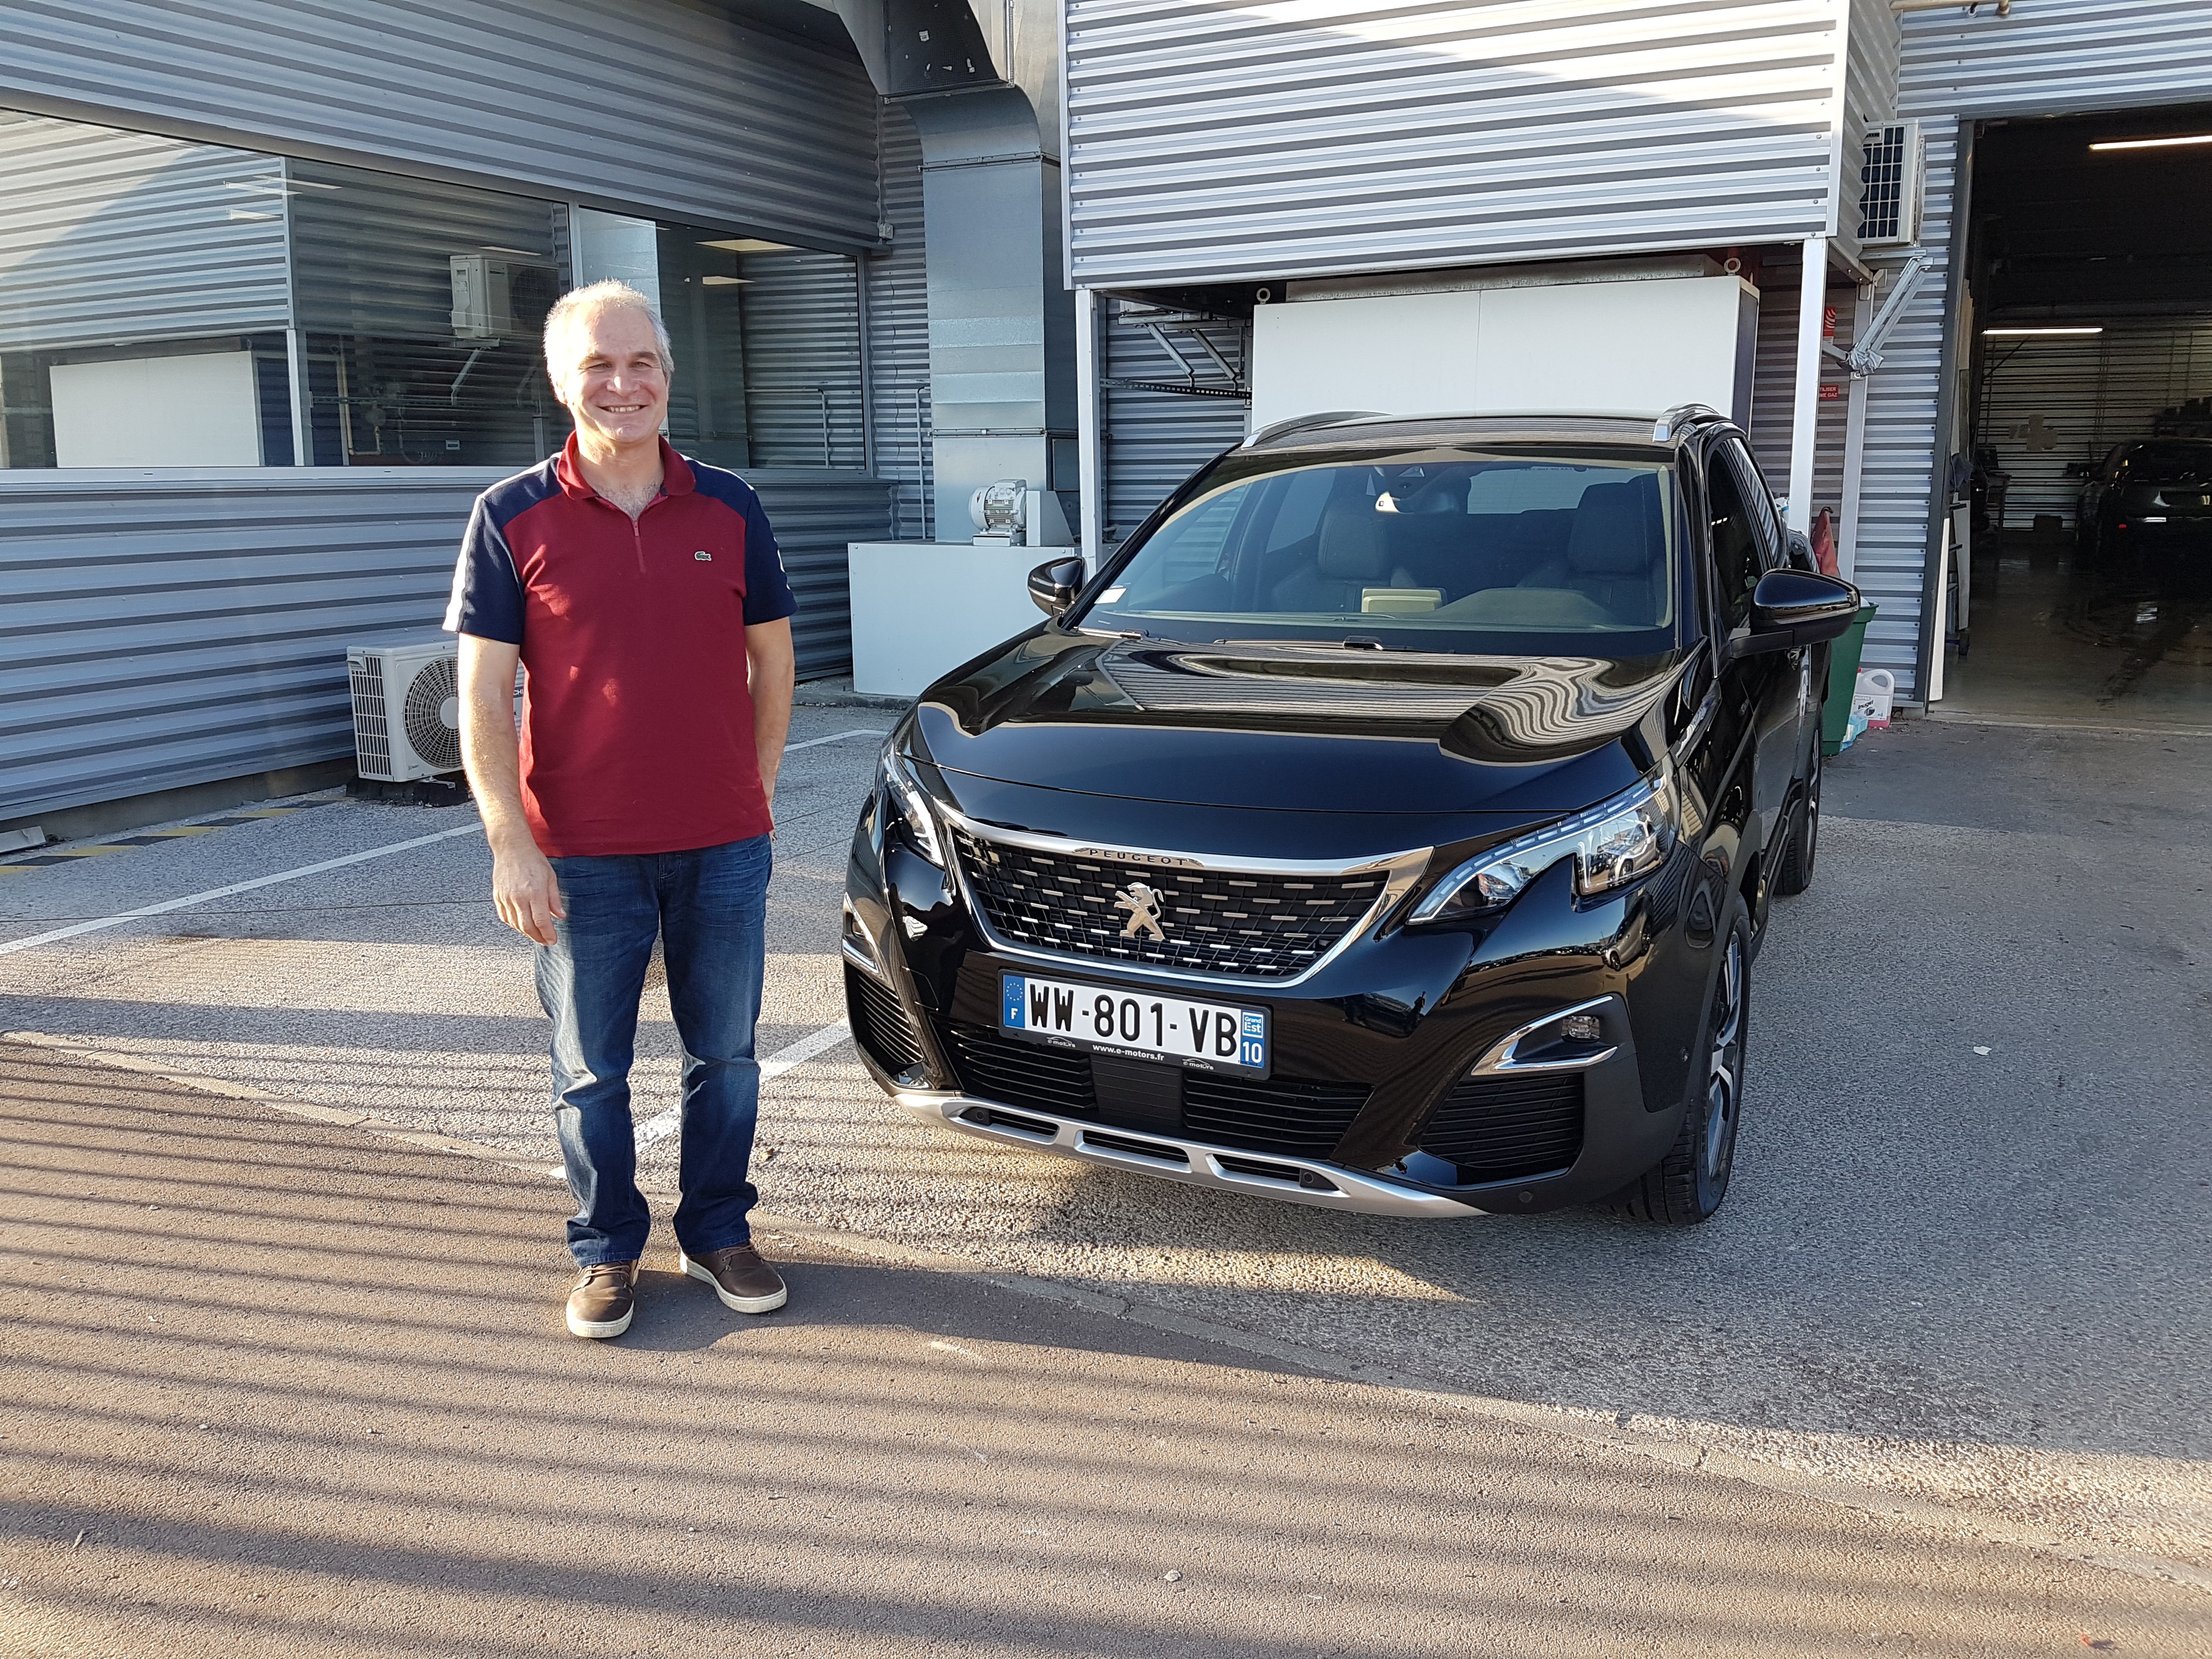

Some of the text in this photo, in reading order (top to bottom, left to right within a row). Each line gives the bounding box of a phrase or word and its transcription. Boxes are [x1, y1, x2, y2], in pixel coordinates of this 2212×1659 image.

[1089, 849, 1187, 866] PEUGEOT
[1011, 1007, 1018, 1019] F
[1244, 1022, 1261, 1032] Est
[1092, 1045, 1165, 1062] www.e-motors.fr
[1243, 1041, 1262, 1063] 10
